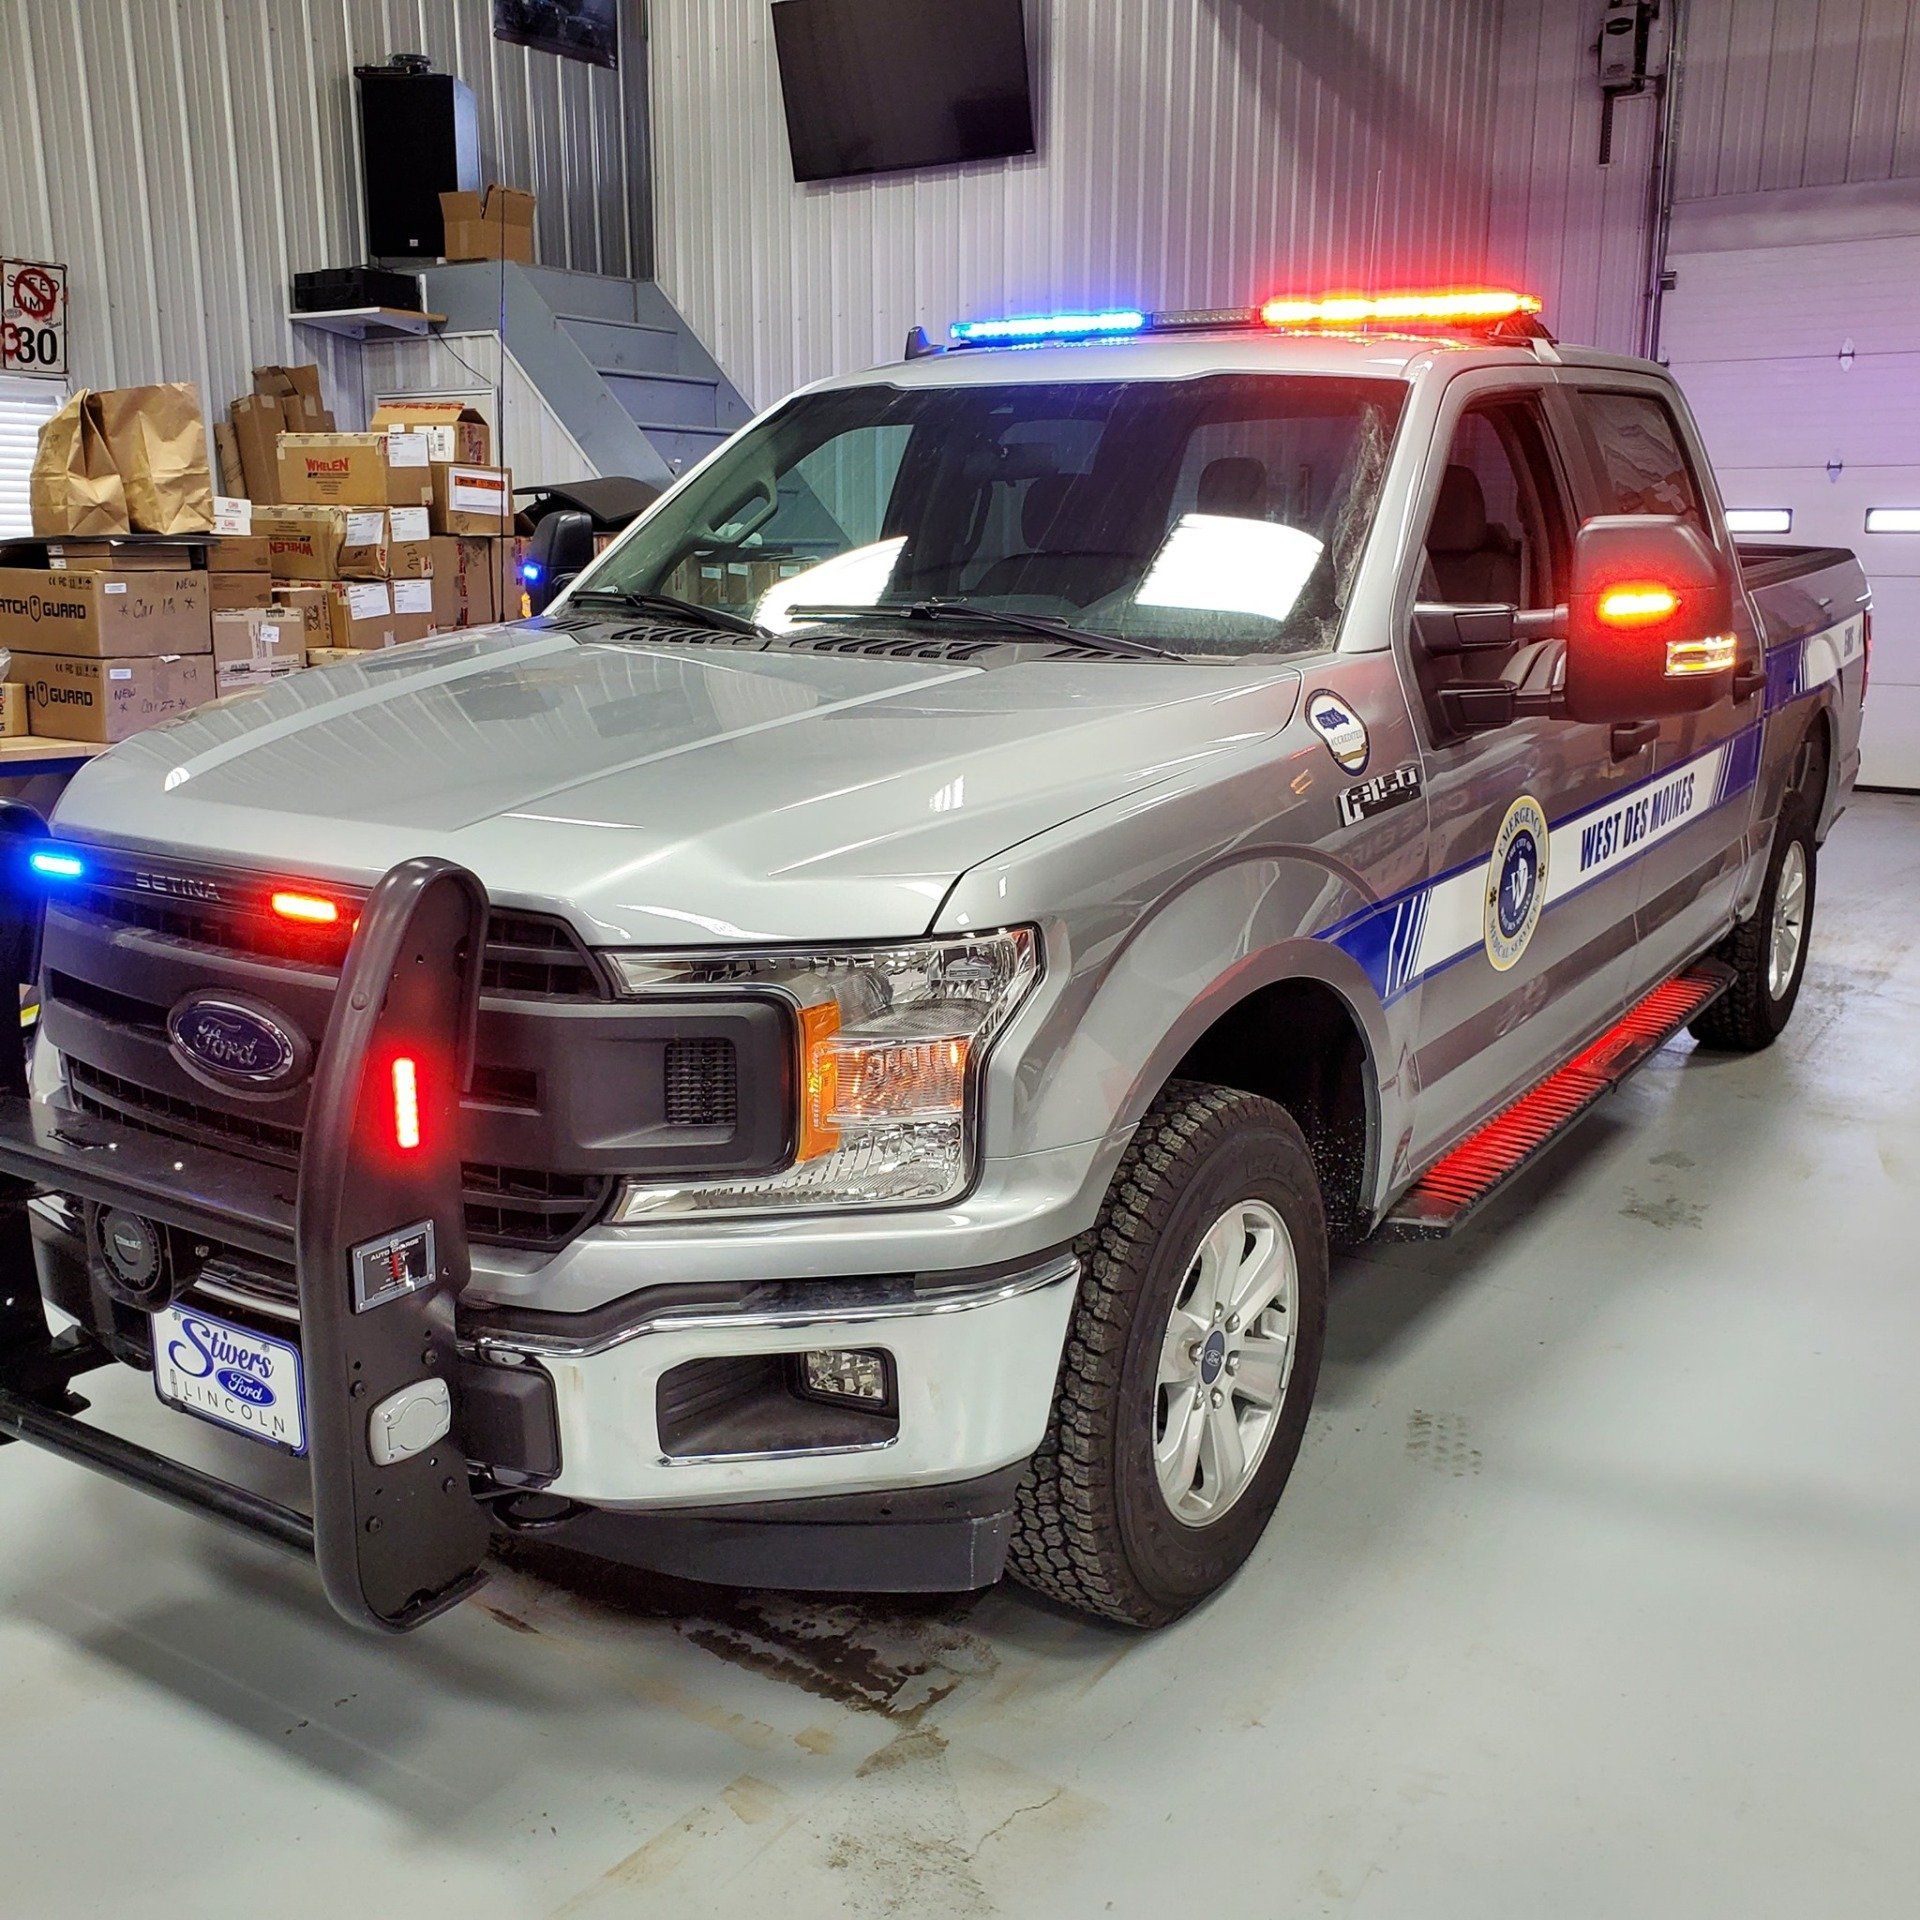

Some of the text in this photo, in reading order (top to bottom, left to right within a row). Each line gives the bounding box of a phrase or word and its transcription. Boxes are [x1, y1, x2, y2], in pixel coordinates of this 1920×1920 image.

[305, 457, 349, 472] WHELEN
[269, 541, 313, 557] WHELEN
[42, 602, 87, 620] GUARD
[49, 687, 94, 707] GUARD
[1498, 807, 1543, 858] EMERGENCY
[1580, 772, 1695, 872] WEST DES MOINES
[136, 872, 221, 900] SETINA
[194, 1016, 259, 1066] Ford
[370, 1249, 391, 1262] AUTO
[168, 1318, 275, 1379] Stivers
[228, 1372, 264, 1401] Ford
[183, 1380, 286, 1435] LINCOLN
